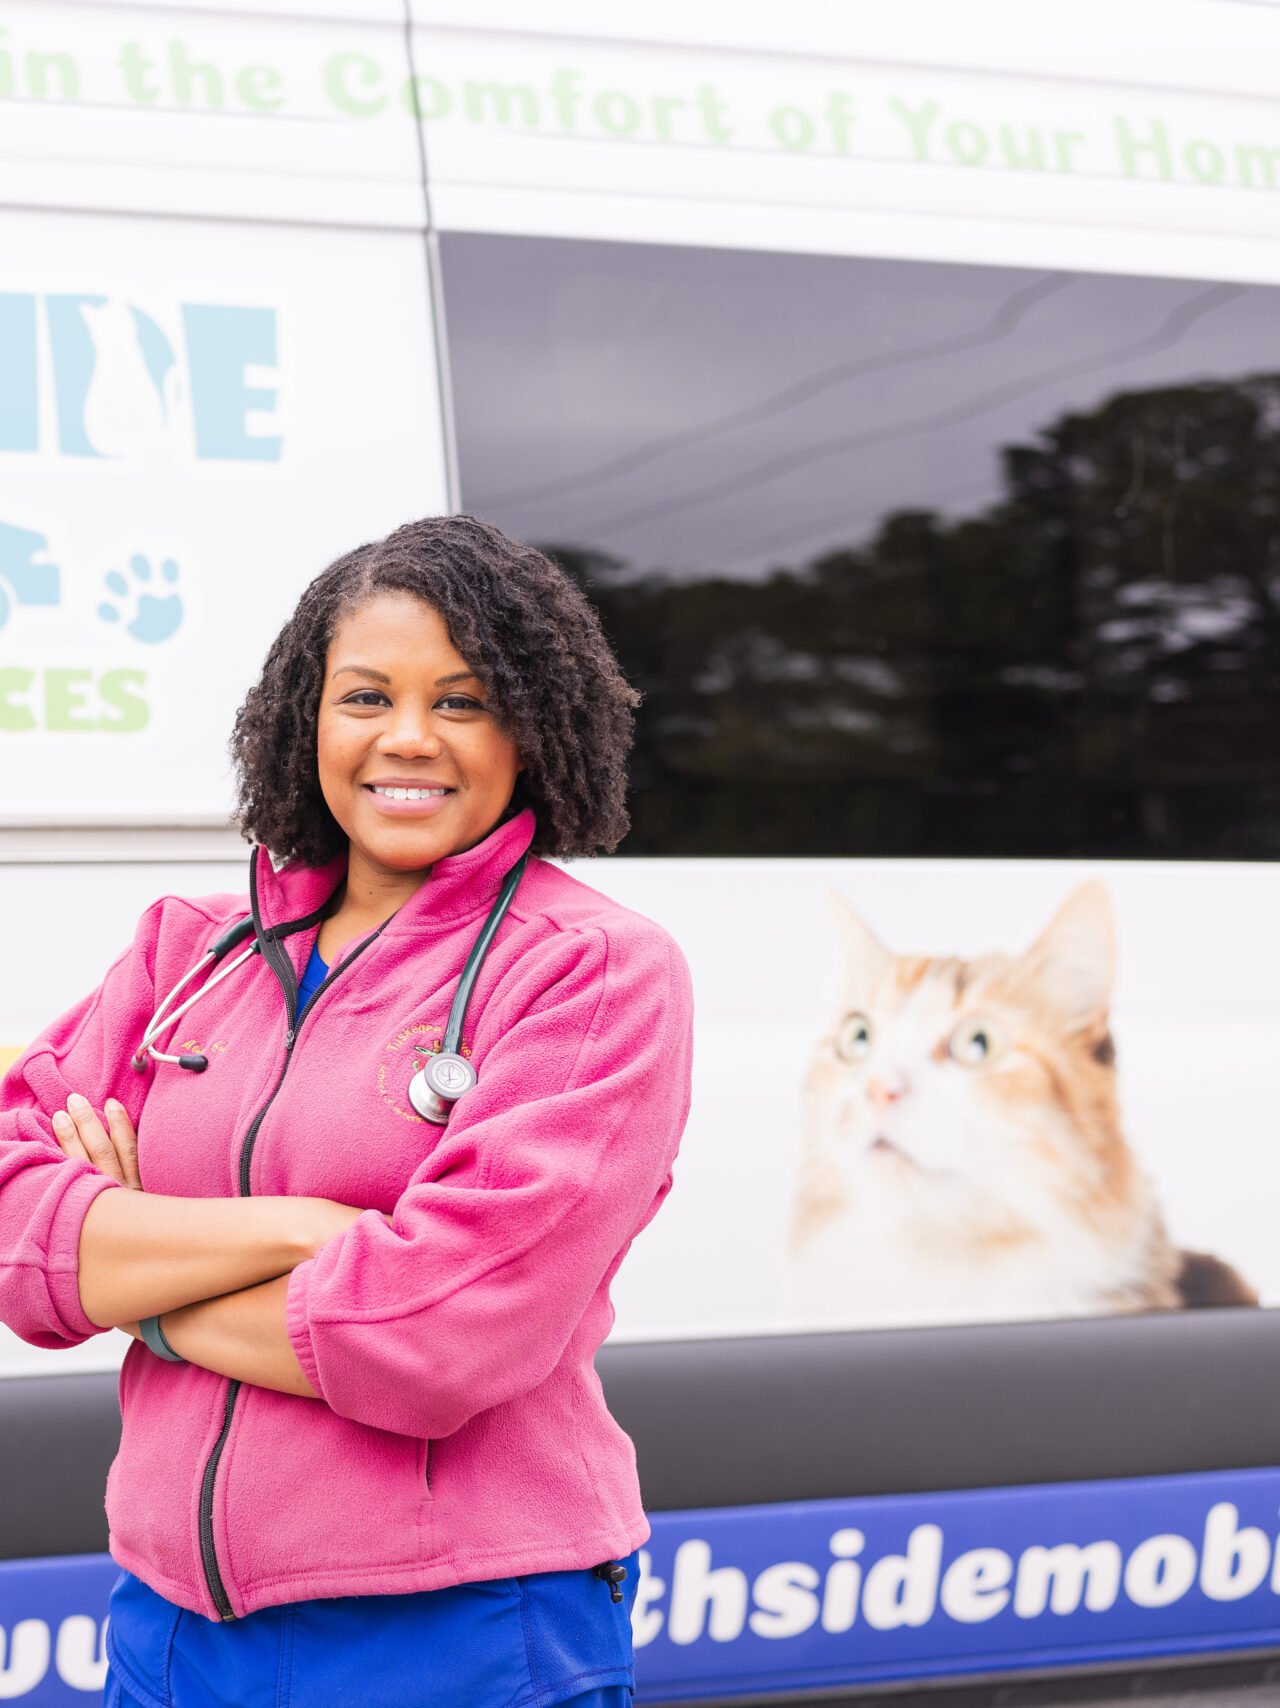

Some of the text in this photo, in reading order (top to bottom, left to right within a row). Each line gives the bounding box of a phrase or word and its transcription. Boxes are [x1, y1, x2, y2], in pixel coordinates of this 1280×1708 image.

[114, 39, 287, 113] the
[322, 51, 734, 146] Comfort
[767, 90, 857, 155] of
[887, 95, 1087, 175] Your
